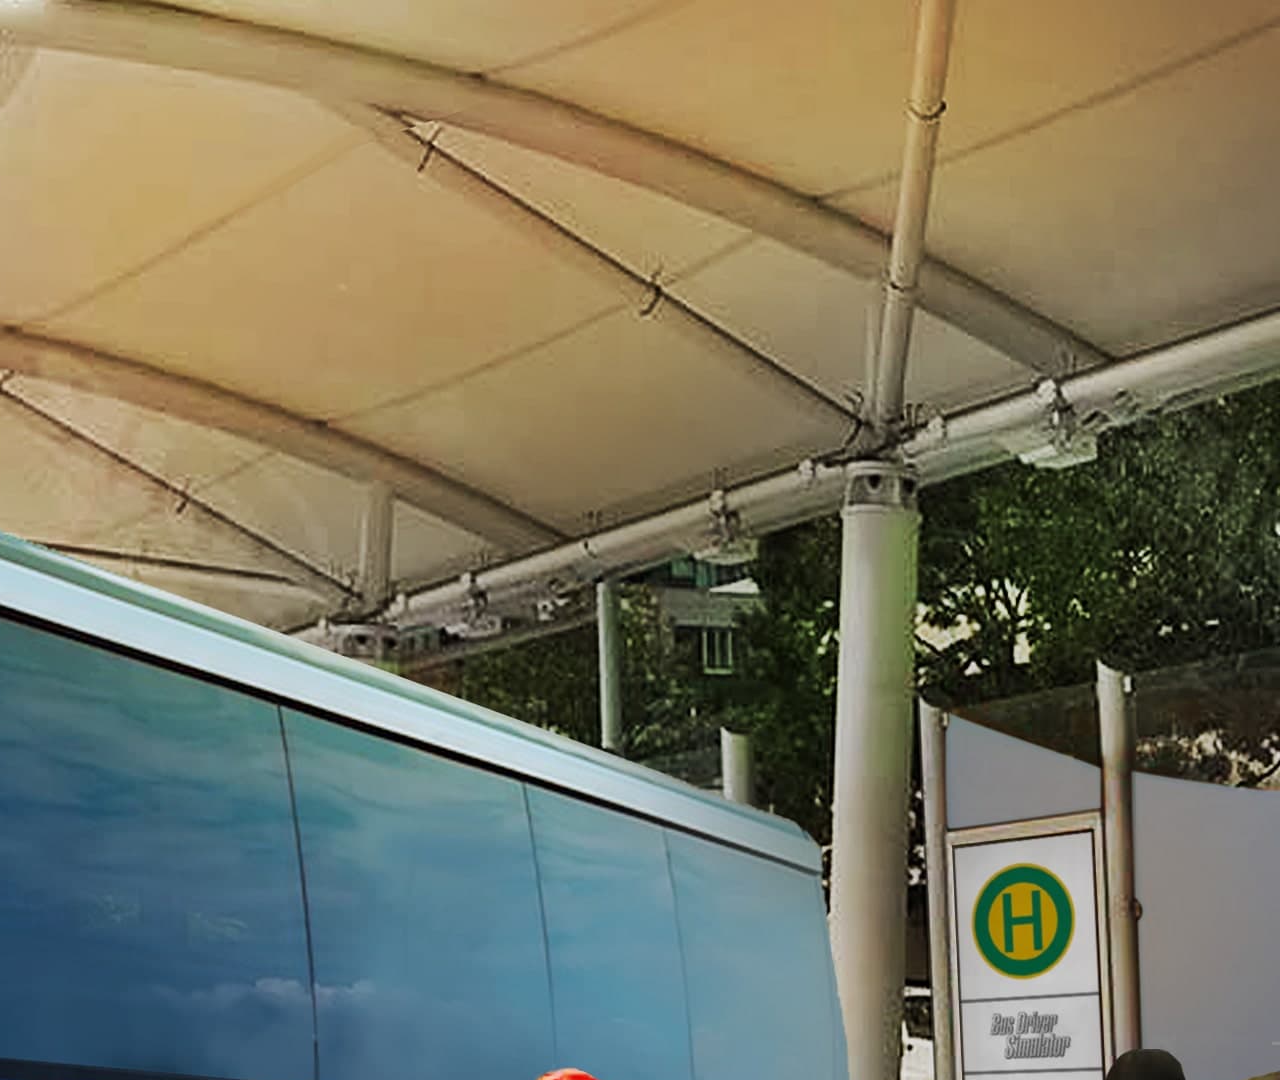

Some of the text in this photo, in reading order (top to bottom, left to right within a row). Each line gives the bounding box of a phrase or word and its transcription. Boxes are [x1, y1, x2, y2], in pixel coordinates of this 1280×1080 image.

[1002, 890, 1043, 953] H
[990, 1010, 1058, 1036] Bus Driver
[1005, 1033, 1072, 1060] Simulator
